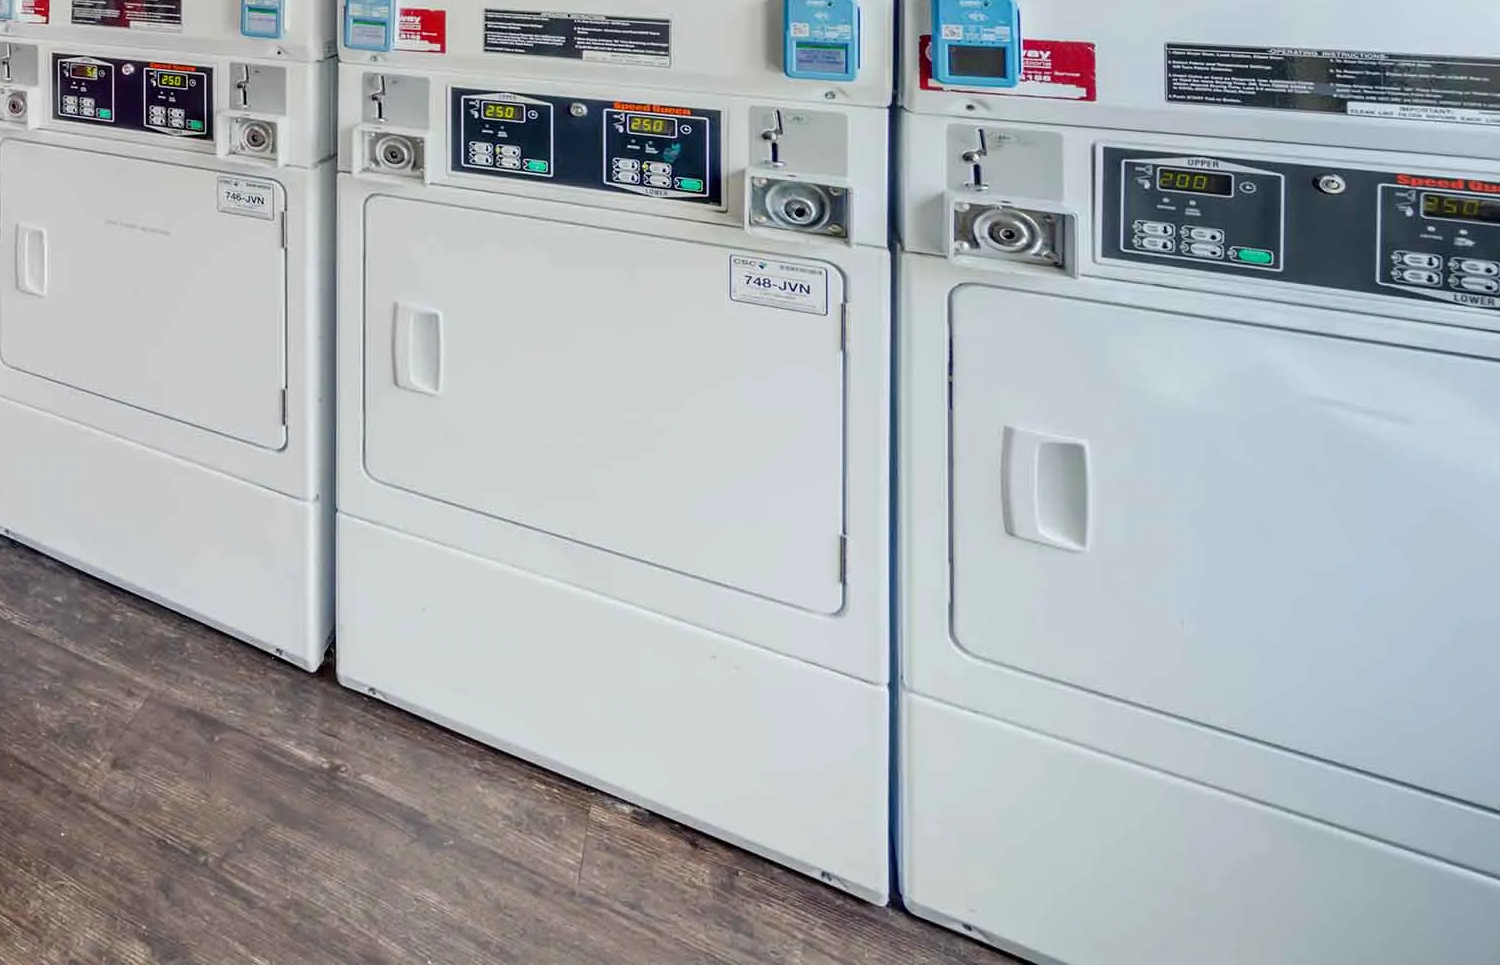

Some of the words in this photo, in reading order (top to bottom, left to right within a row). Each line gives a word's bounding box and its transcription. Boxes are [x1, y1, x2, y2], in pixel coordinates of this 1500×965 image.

[161, 75, 182, 86] 250
[485, 105, 515, 119] 250
[612, 101, 651, 113] Speed
[652, 105, 692, 116] Queen
[630, 117, 665, 133] 250
[1187, 159, 1220, 169] UPPER
[1159, 172, 1209, 190] 200
[1396, 173, 1464, 190] Speed
[225, 191, 265, 205] 746-JVN
[744, 275, 811, 295] 748-JVN
[1453, 294, 1496, 306] LOWER
